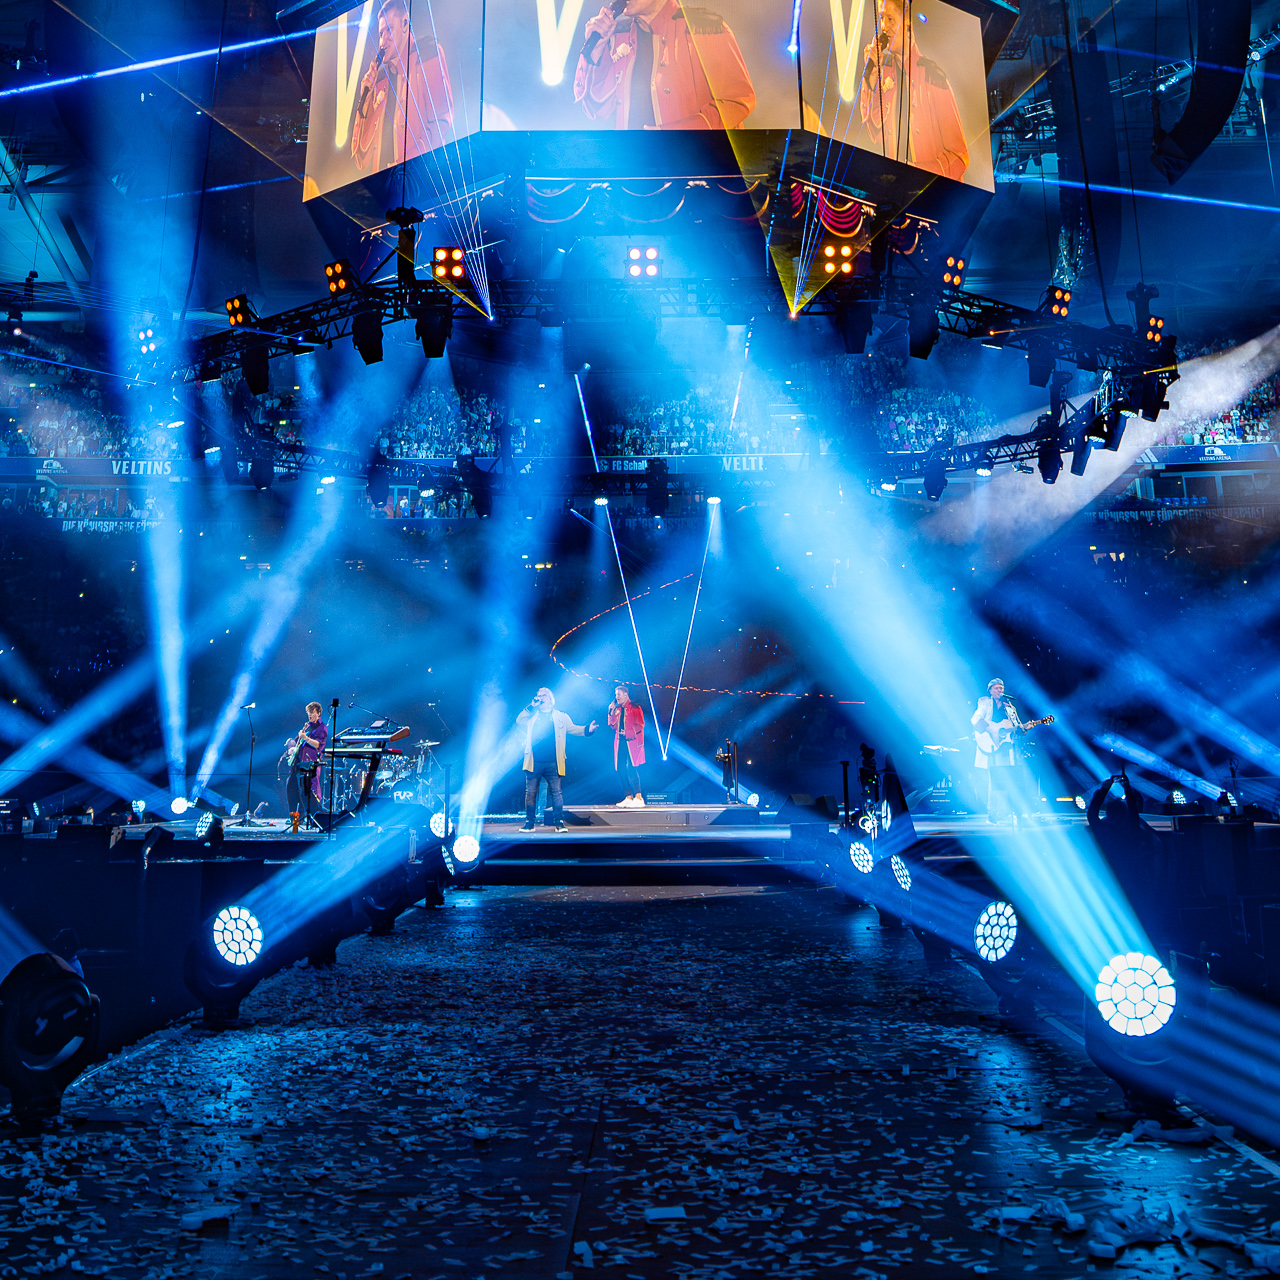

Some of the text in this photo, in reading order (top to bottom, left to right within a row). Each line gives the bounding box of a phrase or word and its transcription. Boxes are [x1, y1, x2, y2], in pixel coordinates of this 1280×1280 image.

[112, 460, 172, 475] VELTINS
[612, 460, 647, 471] FC Schal
[722, 456, 764, 471] VELTI
[393, 790, 413, 801] PUR
